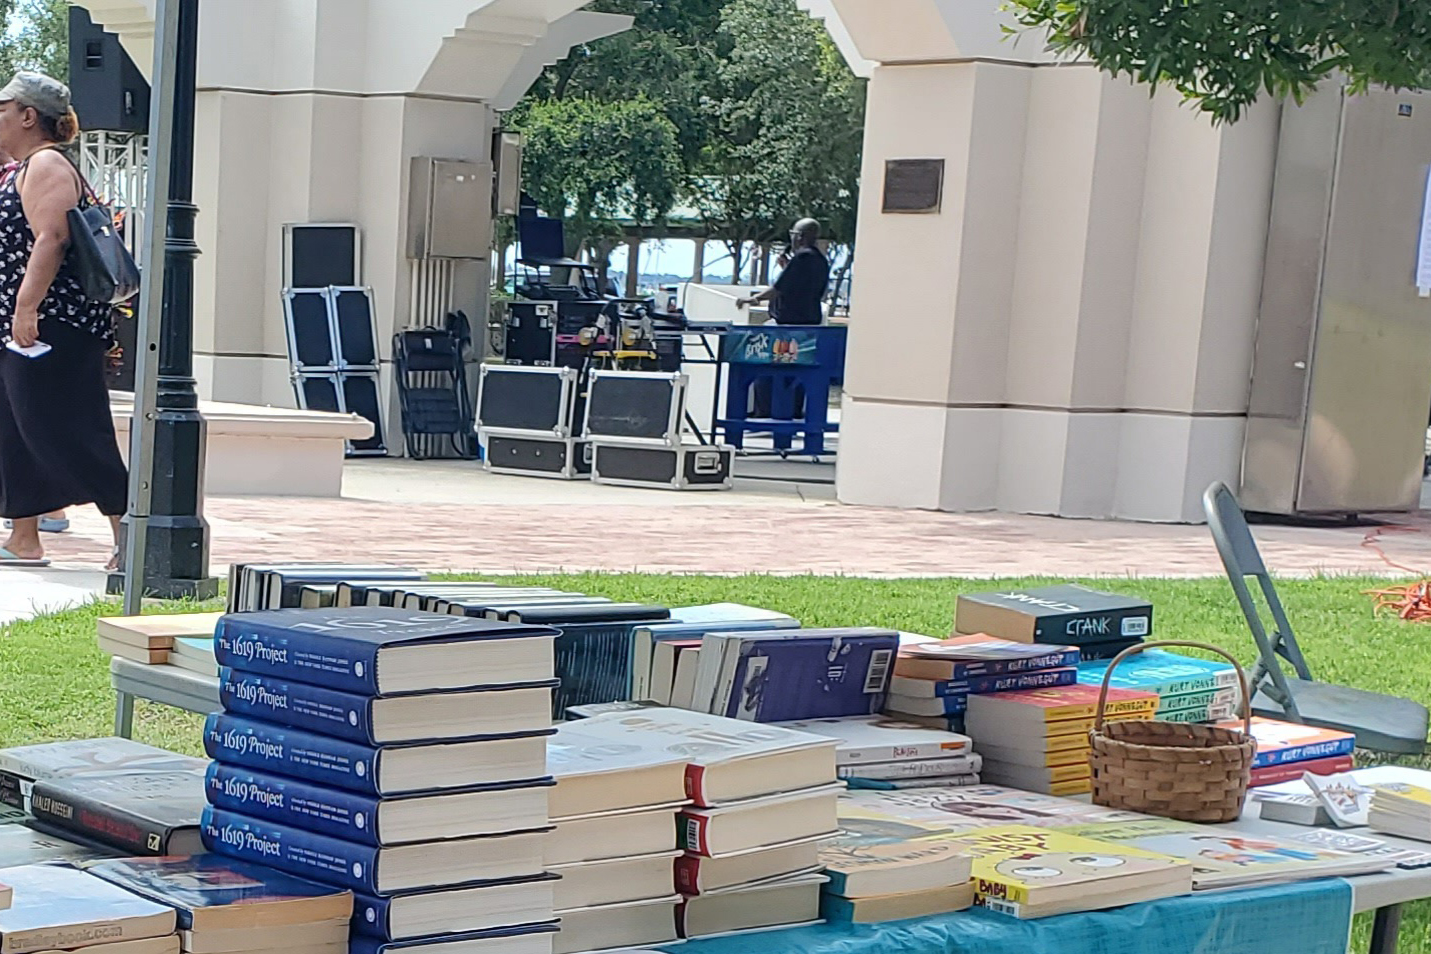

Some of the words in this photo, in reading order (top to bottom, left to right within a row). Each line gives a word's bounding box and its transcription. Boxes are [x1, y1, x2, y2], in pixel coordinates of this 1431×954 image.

[219, 638, 230, 649] The
[232, 636, 254, 662] 1619
[255, 642, 288, 665] Project
[225, 681, 235, 693] The
[236, 680, 256, 705] 1619
[257, 686, 288, 710] Project
[210, 731, 221, 742] The
[223, 728, 246, 755] 1619
[248, 735, 283, 759] Project
[211, 778, 222, 790] The
[224, 776, 247, 802] 1619
[249, 784, 284, 808] Project
[207, 826, 218, 837] The
[221, 824, 244, 850] 1619
[245, 832, 281, 857] Project
[979, 880, 1007, 899] BABY
